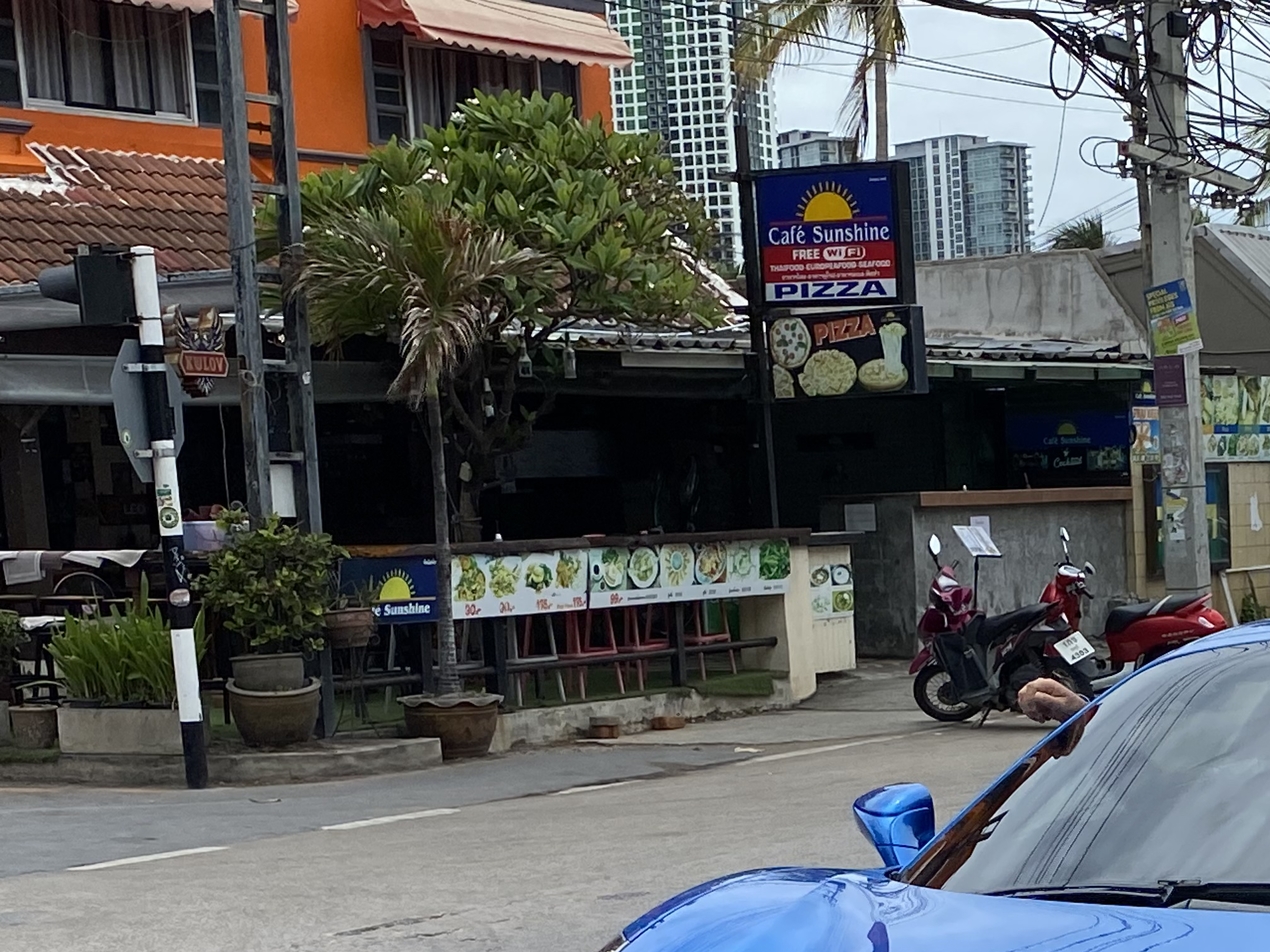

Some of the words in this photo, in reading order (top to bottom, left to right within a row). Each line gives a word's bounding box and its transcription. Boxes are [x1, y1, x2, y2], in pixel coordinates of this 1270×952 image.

[768, 225, 806, 246] Café
[813, 222, 890, 244] Sunshine
[792, 248, 820, 260] FREE
[774, 280, 888, 300] PIZZA
[813, 313, 877, 346] PIZZA
[383, 602, 431, 616] Sunshine
